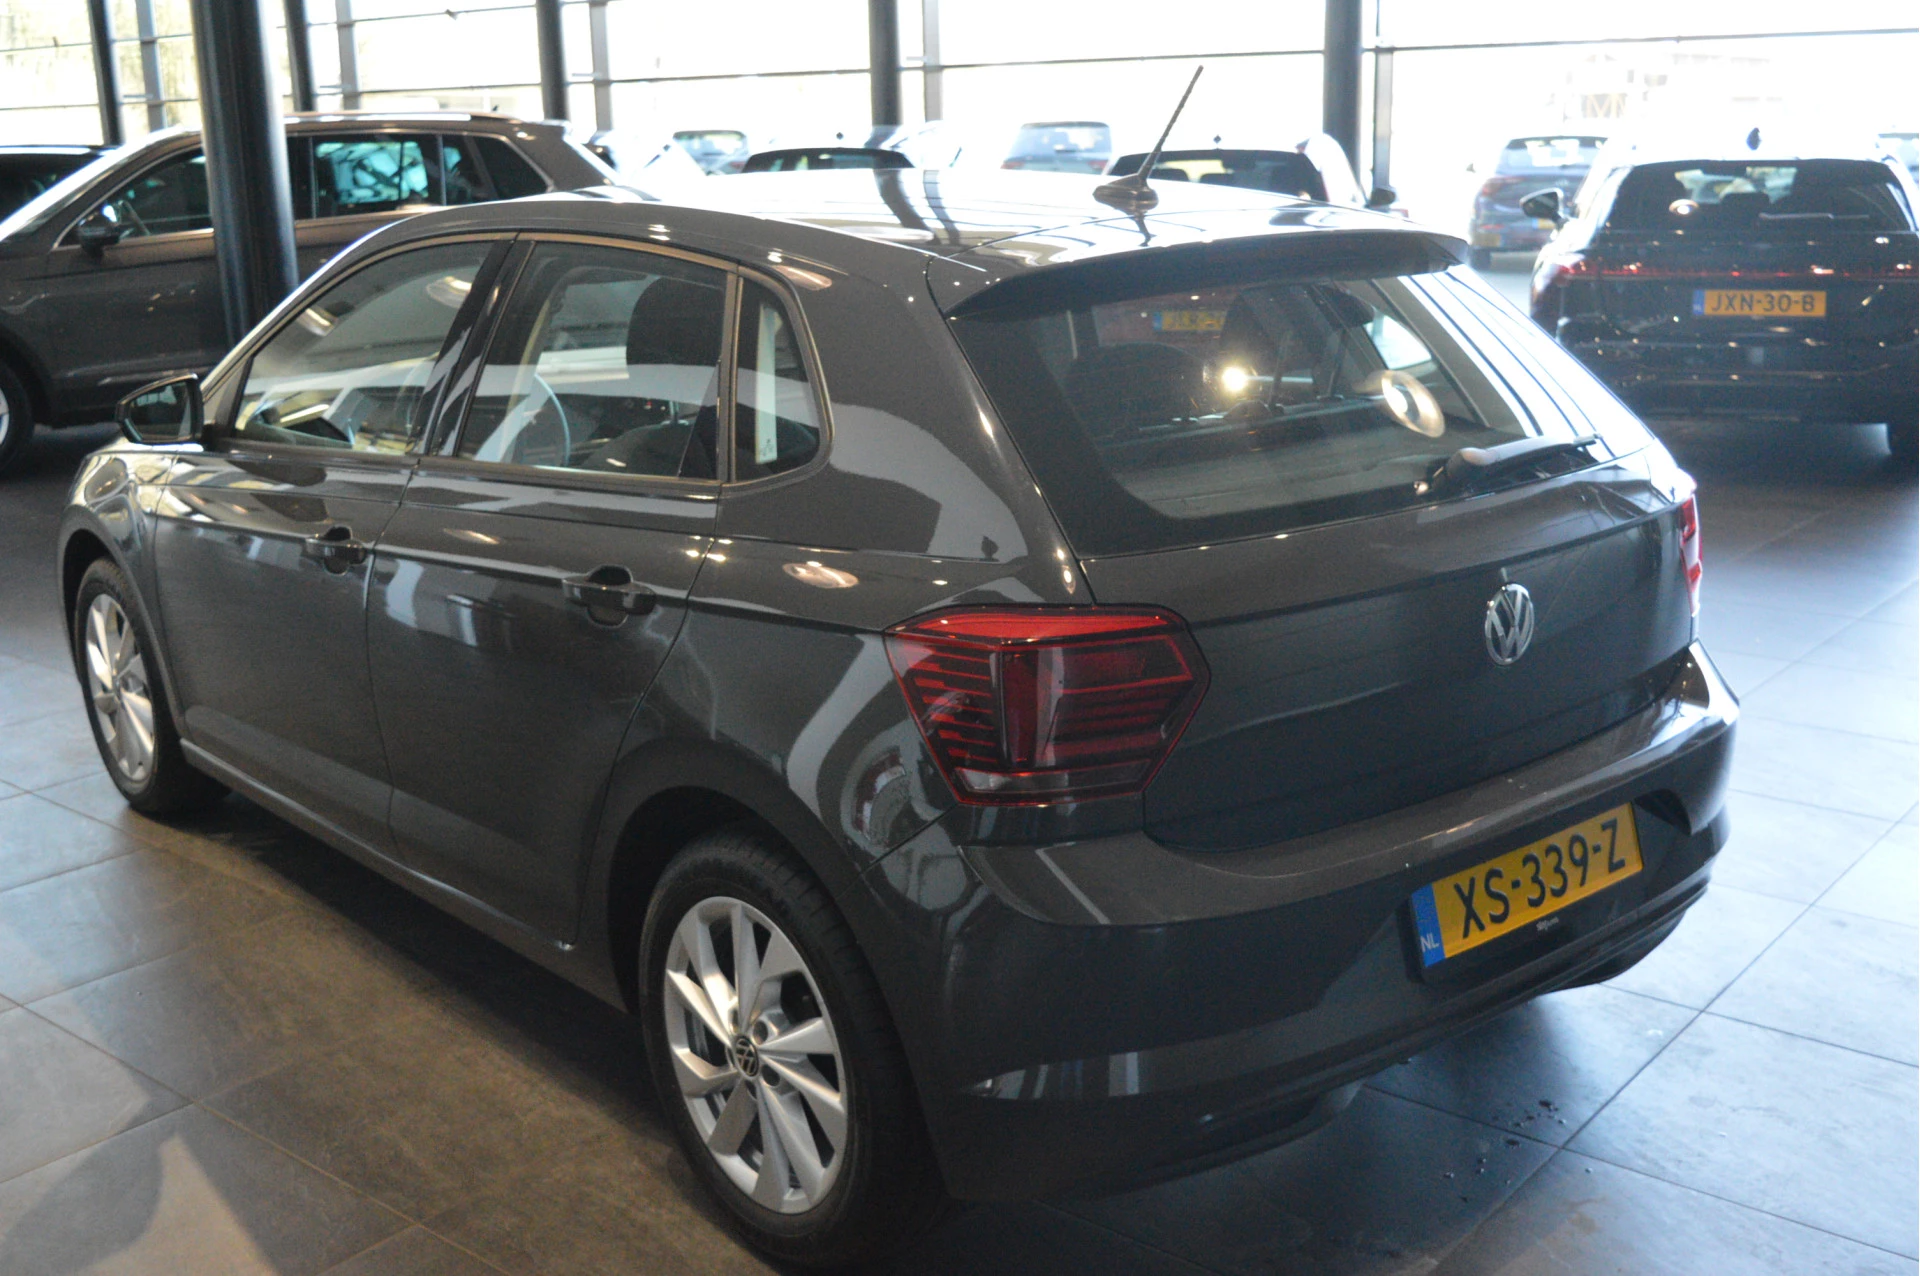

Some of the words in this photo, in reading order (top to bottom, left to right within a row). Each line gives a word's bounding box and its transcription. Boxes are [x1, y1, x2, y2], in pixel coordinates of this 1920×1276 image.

[1711, 293, 1816, 313] JXN-30-B
[1453, 817, 1626, 939] XS-339-Z
[1420, 932, 1440, 953] NL
